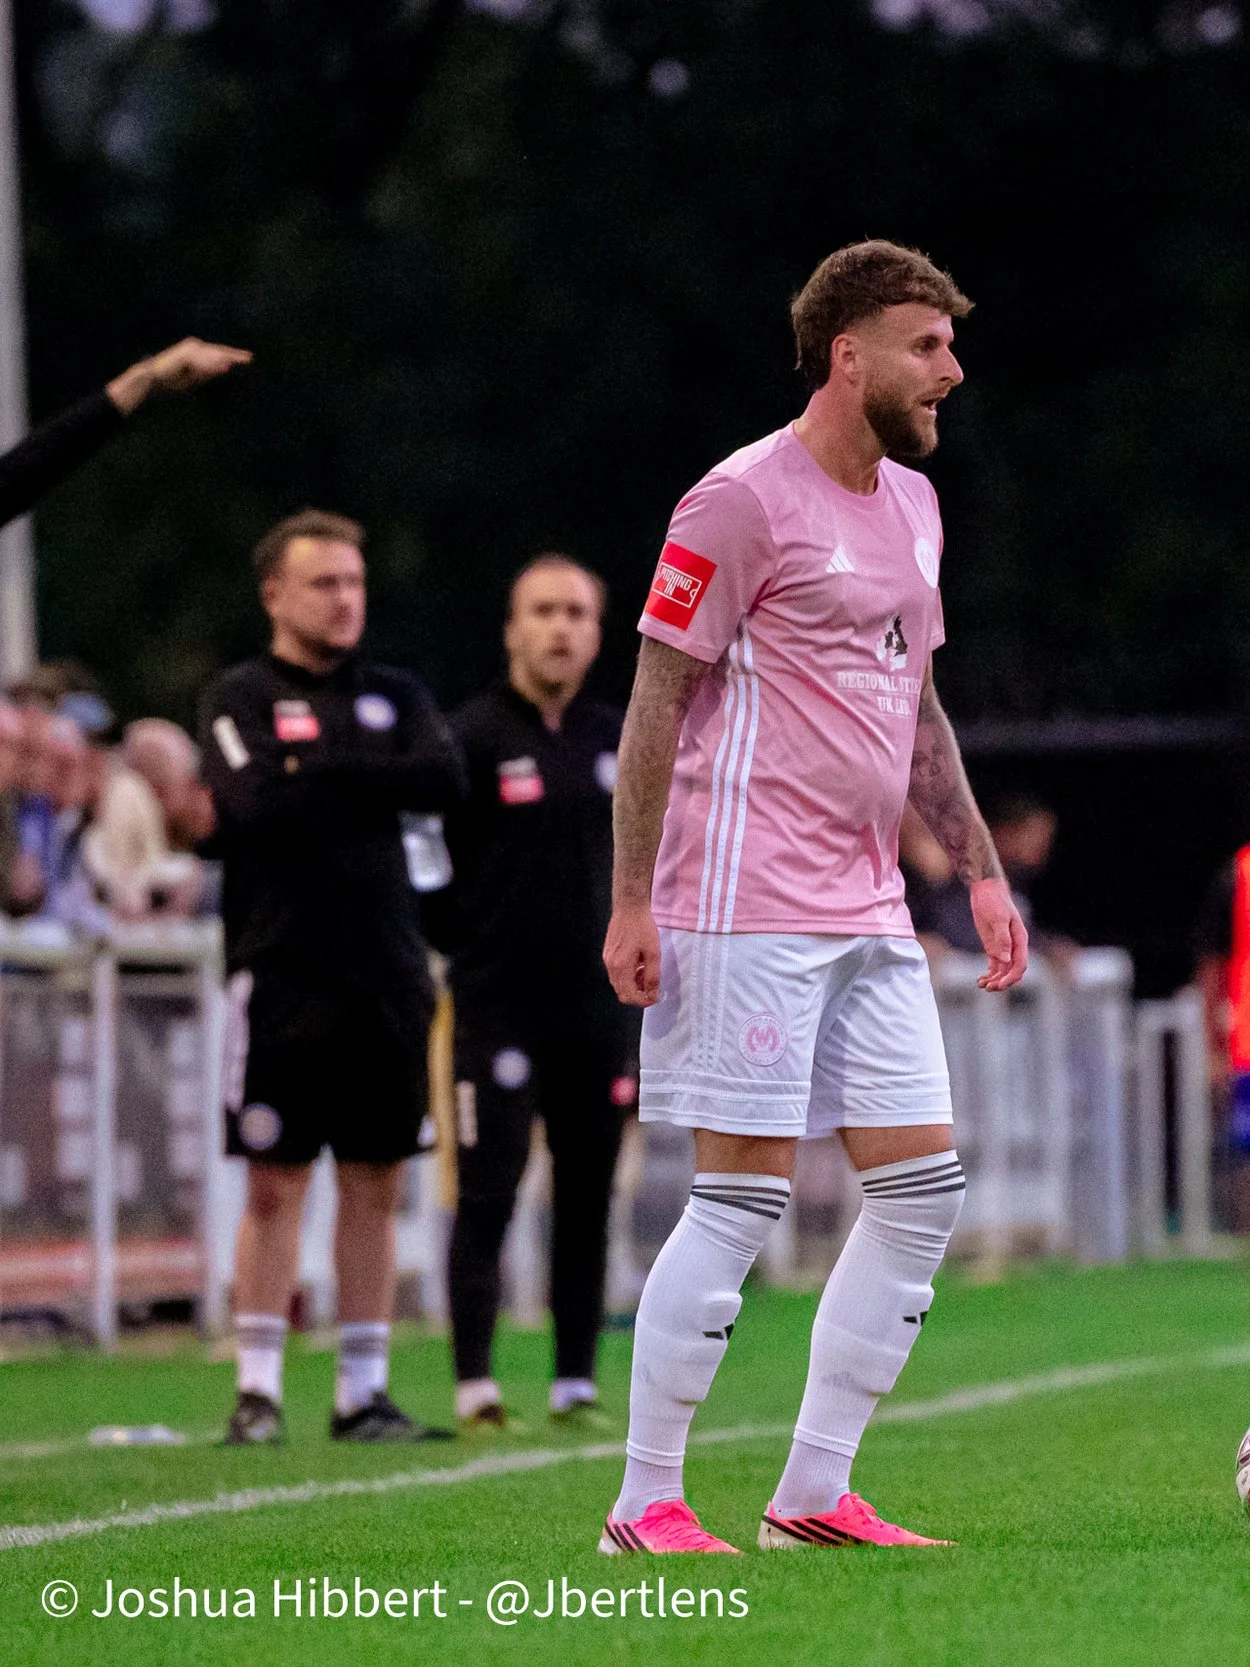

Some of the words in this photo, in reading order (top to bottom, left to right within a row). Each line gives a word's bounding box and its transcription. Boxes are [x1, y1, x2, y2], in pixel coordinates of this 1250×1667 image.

[659, 566, 693, 591] PITCHING
[663, 580, 677, 596] IN
[837, 671, 897, 692] REGIONAL
[877, 696, 894, 713] UK
